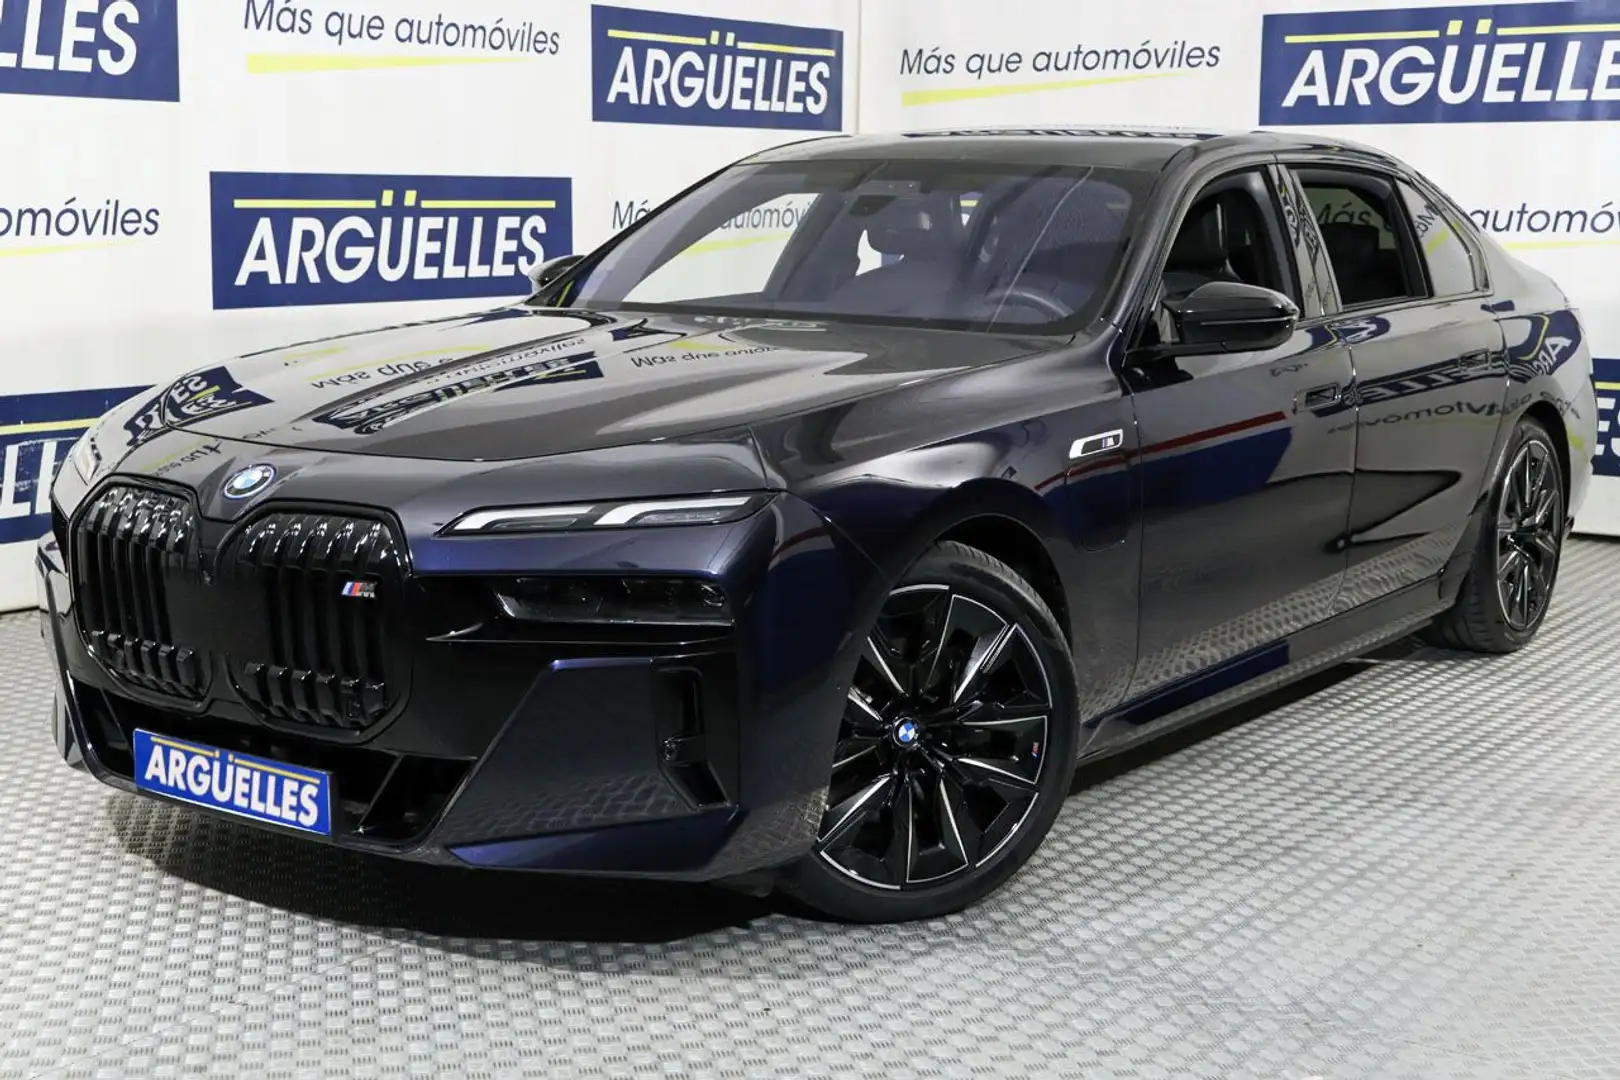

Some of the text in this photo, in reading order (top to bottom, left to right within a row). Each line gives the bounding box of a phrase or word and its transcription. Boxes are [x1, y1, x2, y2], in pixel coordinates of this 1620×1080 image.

[243, 0, 561, 55] Más que automóviles
[900, 40, 1221, 79] Más que automóviles
[606, 30, 831, 115] ARGÜELLES
[234, 190, 548, 286] ARGÜELLES
[144, 744, 319, 827] ARGÜELLES
